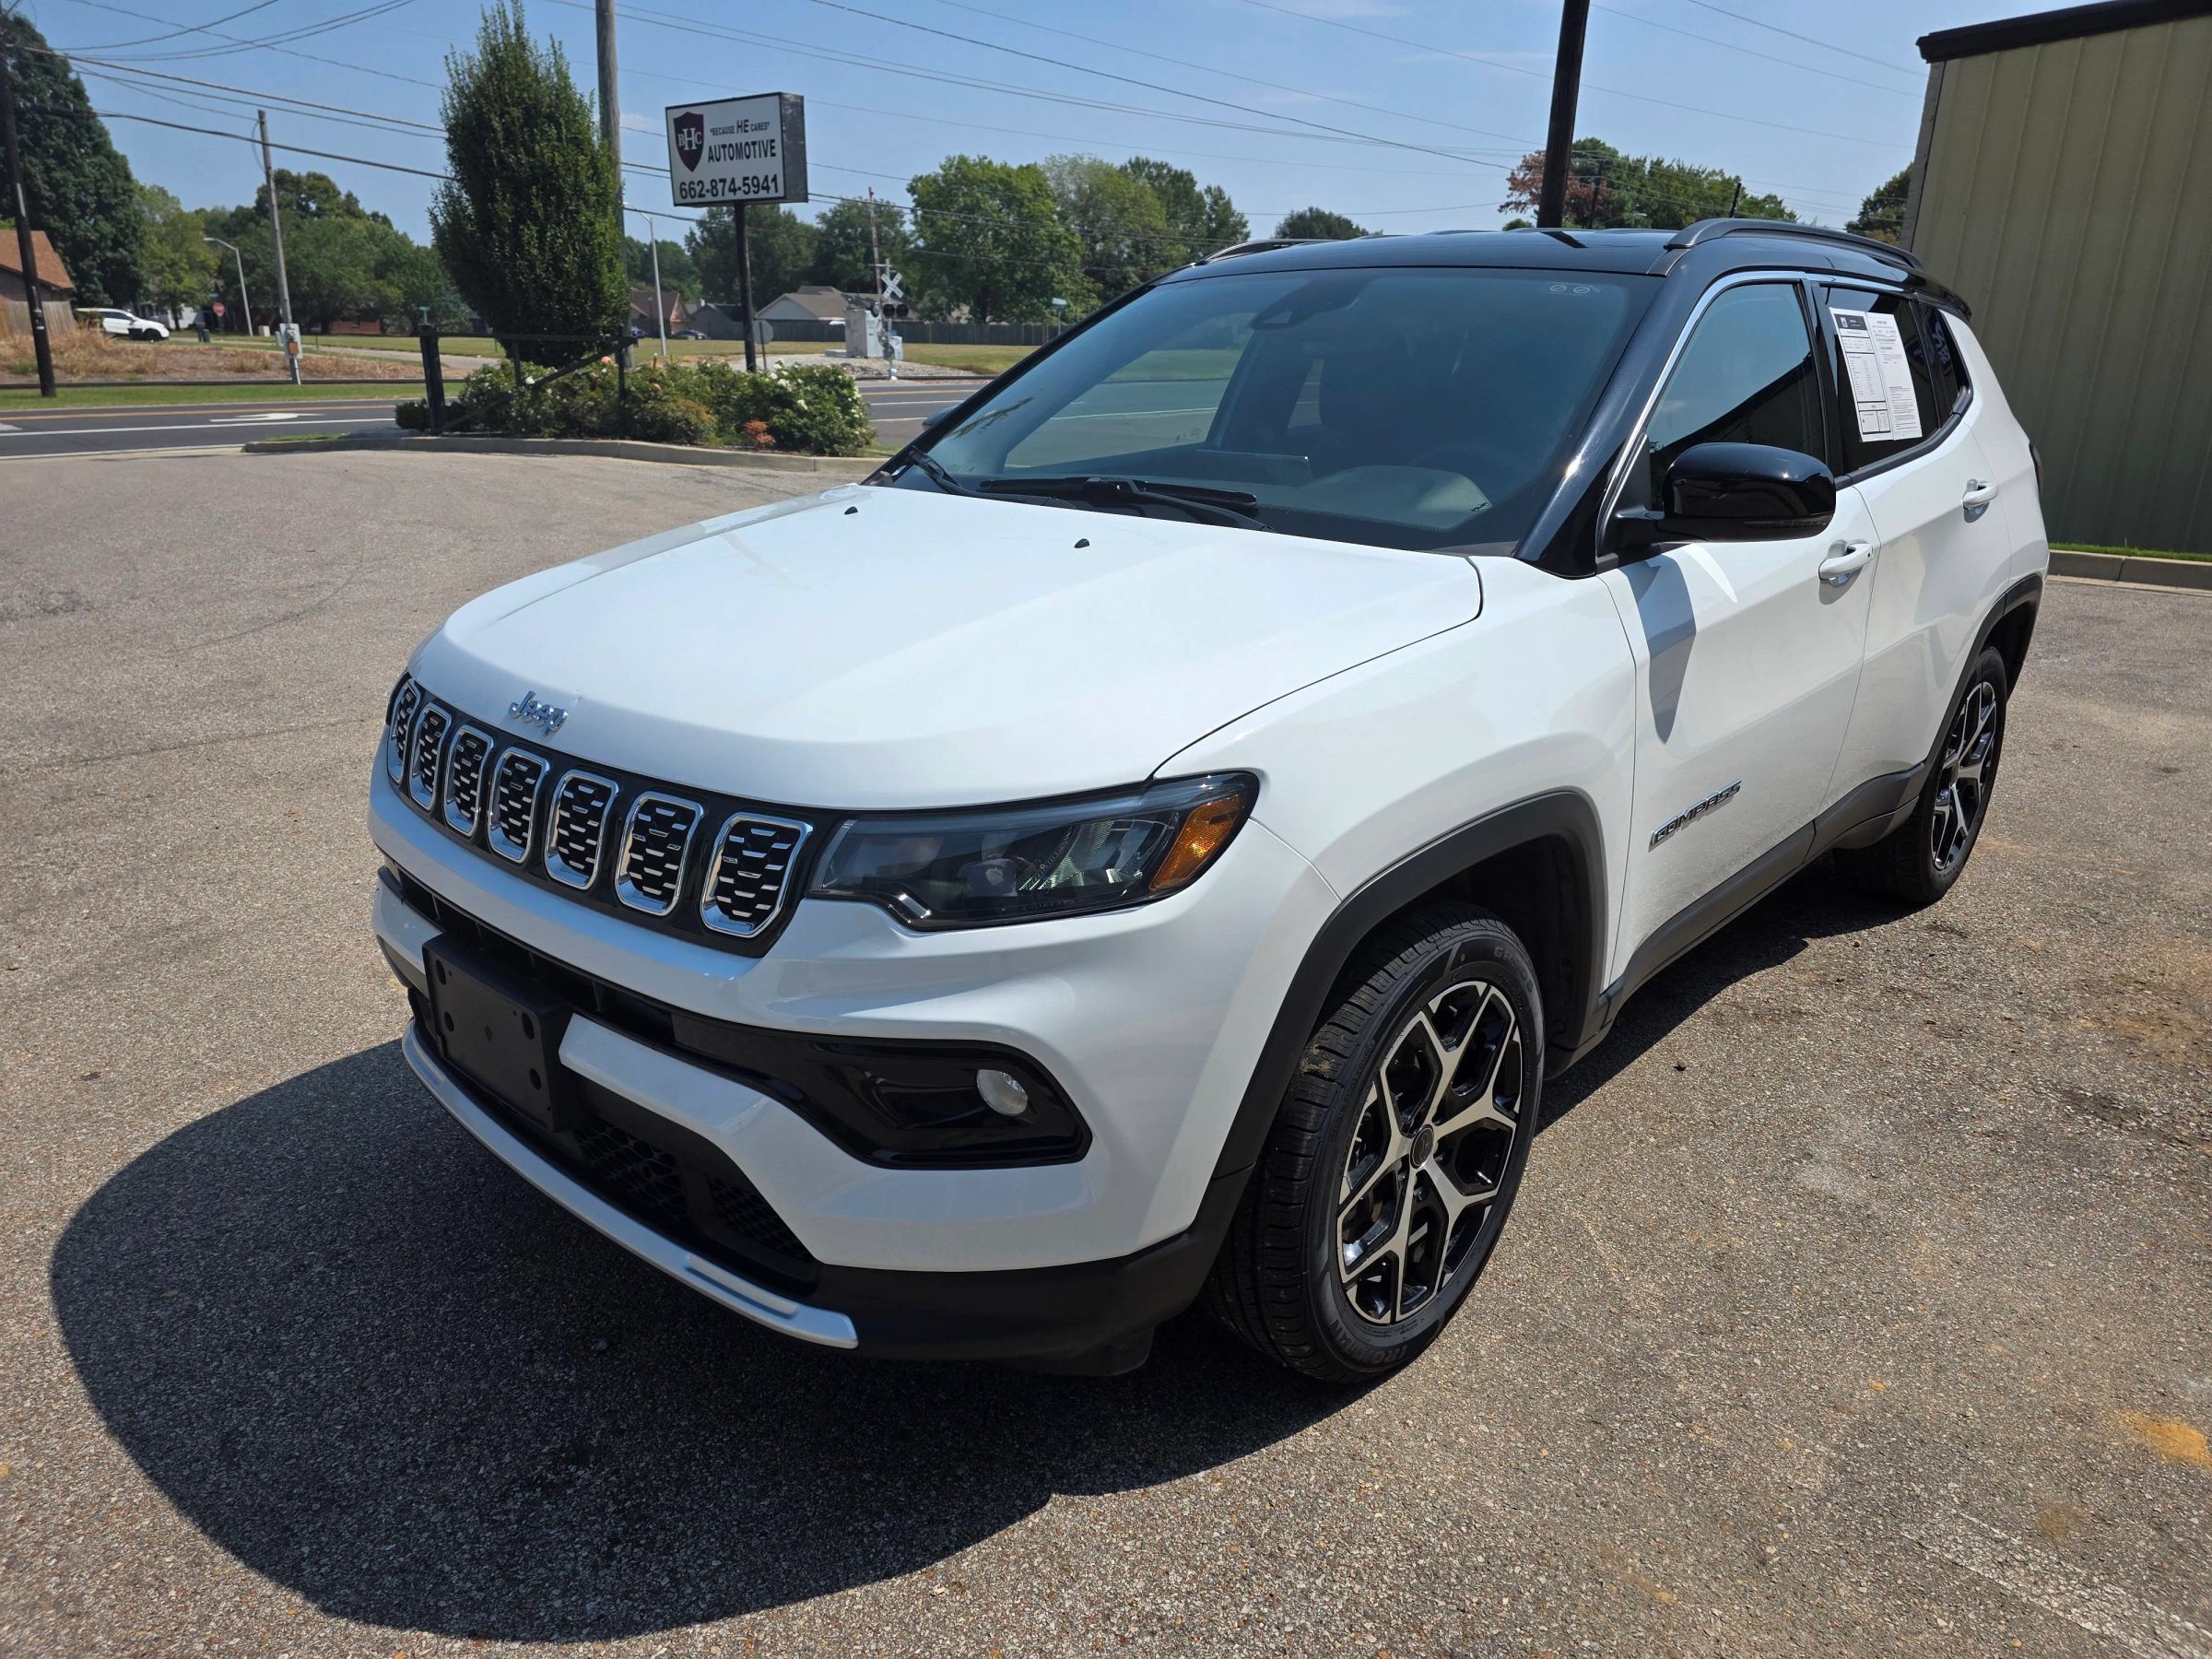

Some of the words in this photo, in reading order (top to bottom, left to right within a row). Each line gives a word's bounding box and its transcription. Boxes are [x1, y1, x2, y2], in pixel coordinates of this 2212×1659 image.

[736, 119, 749, 135] HE
[708, 138, 776, 163] AUTOMOTIVE
[679, 173, 778, 200] 662-874-5941
[508, 690, 569, 737] Jeep
[1651, 780, 1742, 844] COMPASS
